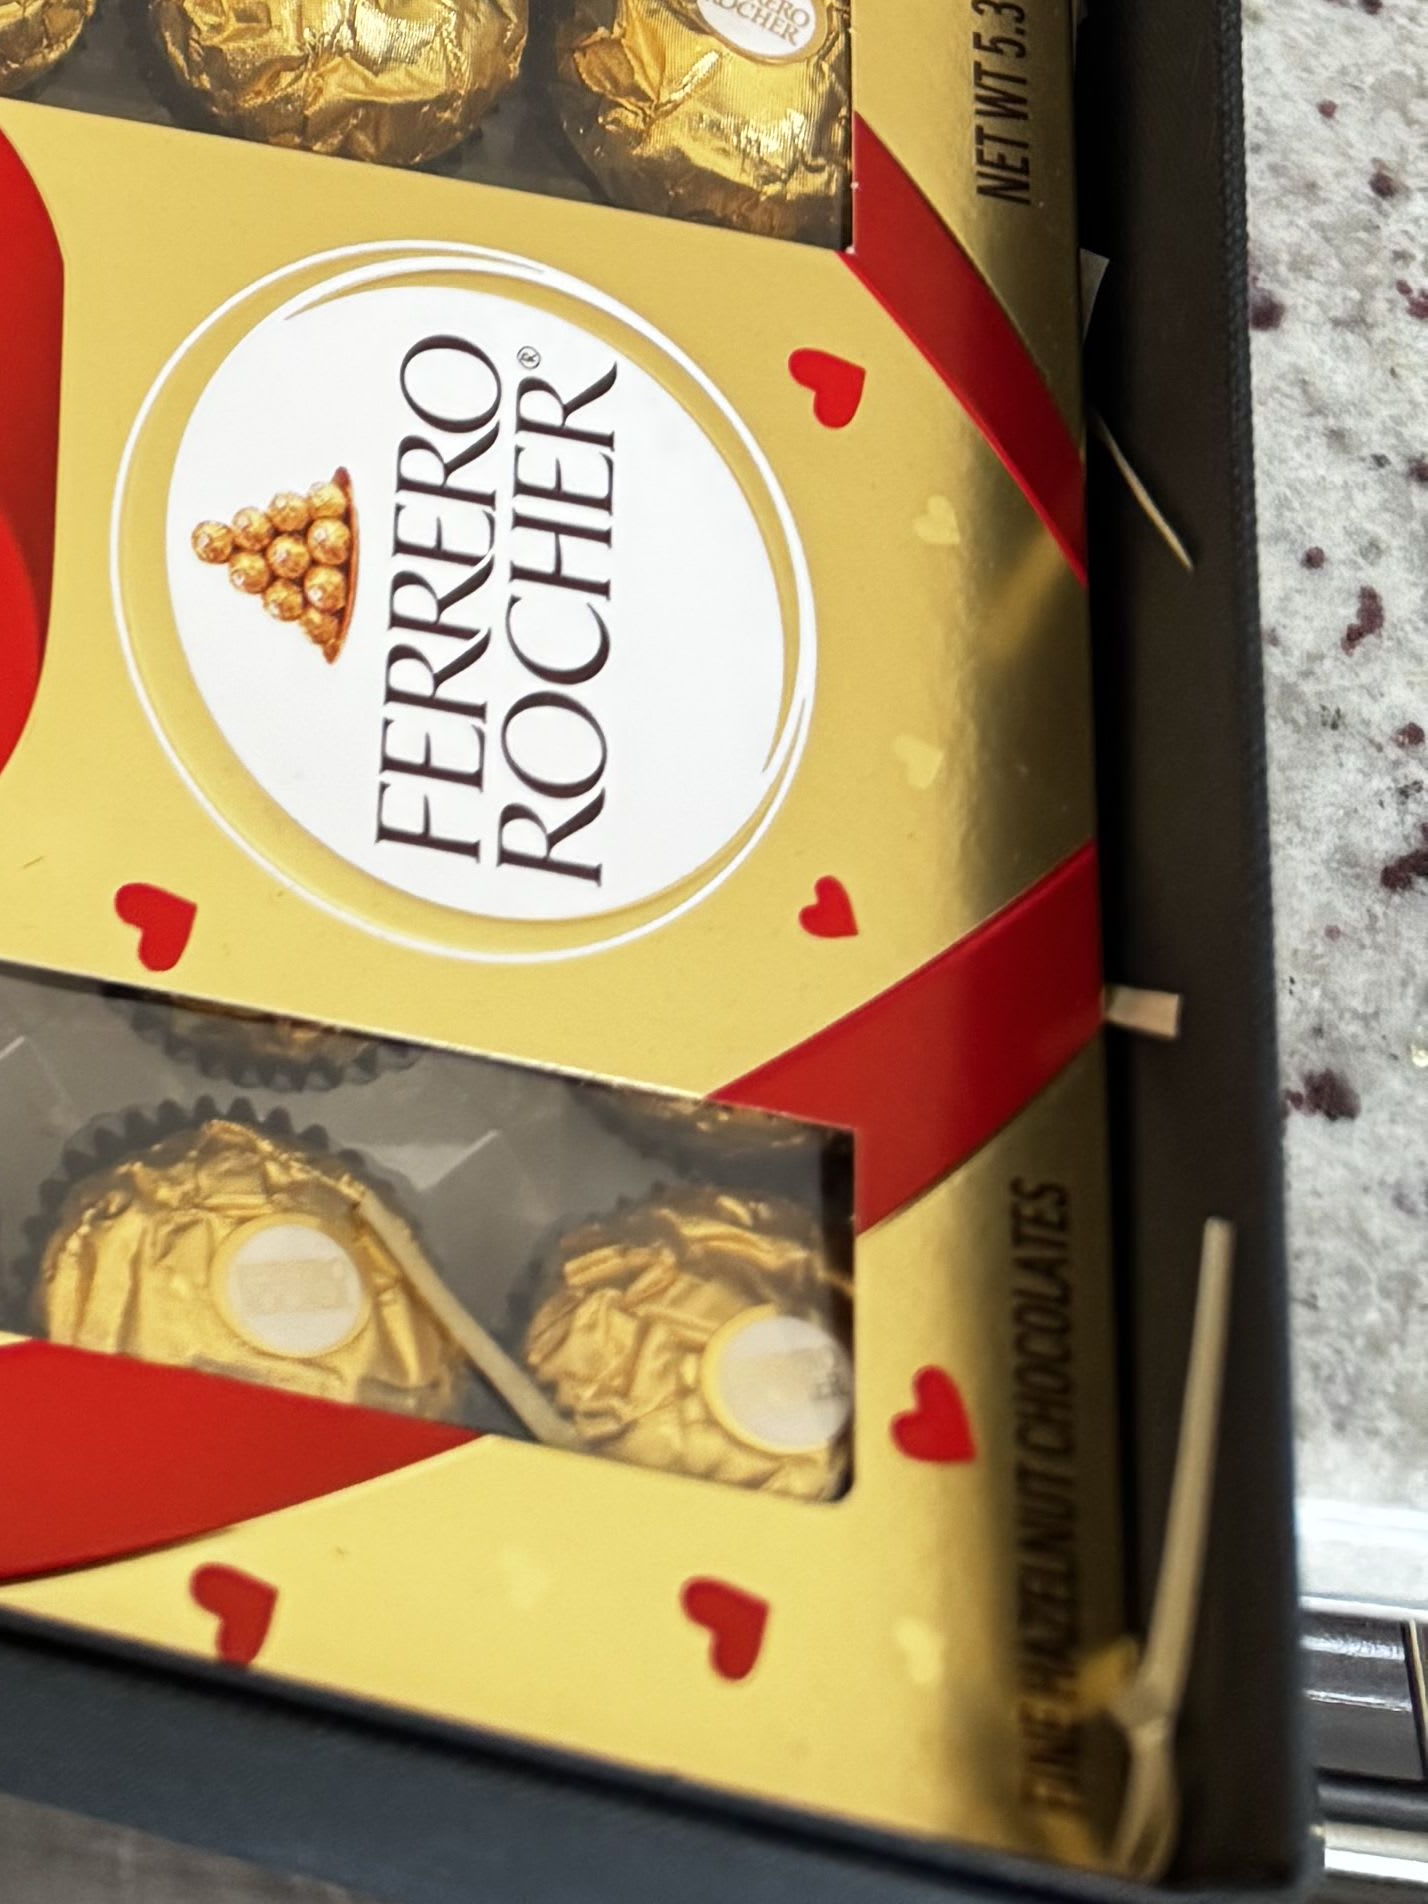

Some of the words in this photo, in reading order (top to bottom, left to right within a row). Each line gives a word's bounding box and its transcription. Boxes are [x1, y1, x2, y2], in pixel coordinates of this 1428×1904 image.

[972, 61, 1029, 122] WT
[976, 126, 1032, 206] NET
[374, 332, 504, 863] FERRERO
[1011, 1175, 1075, 1459] CHOCOLATES
